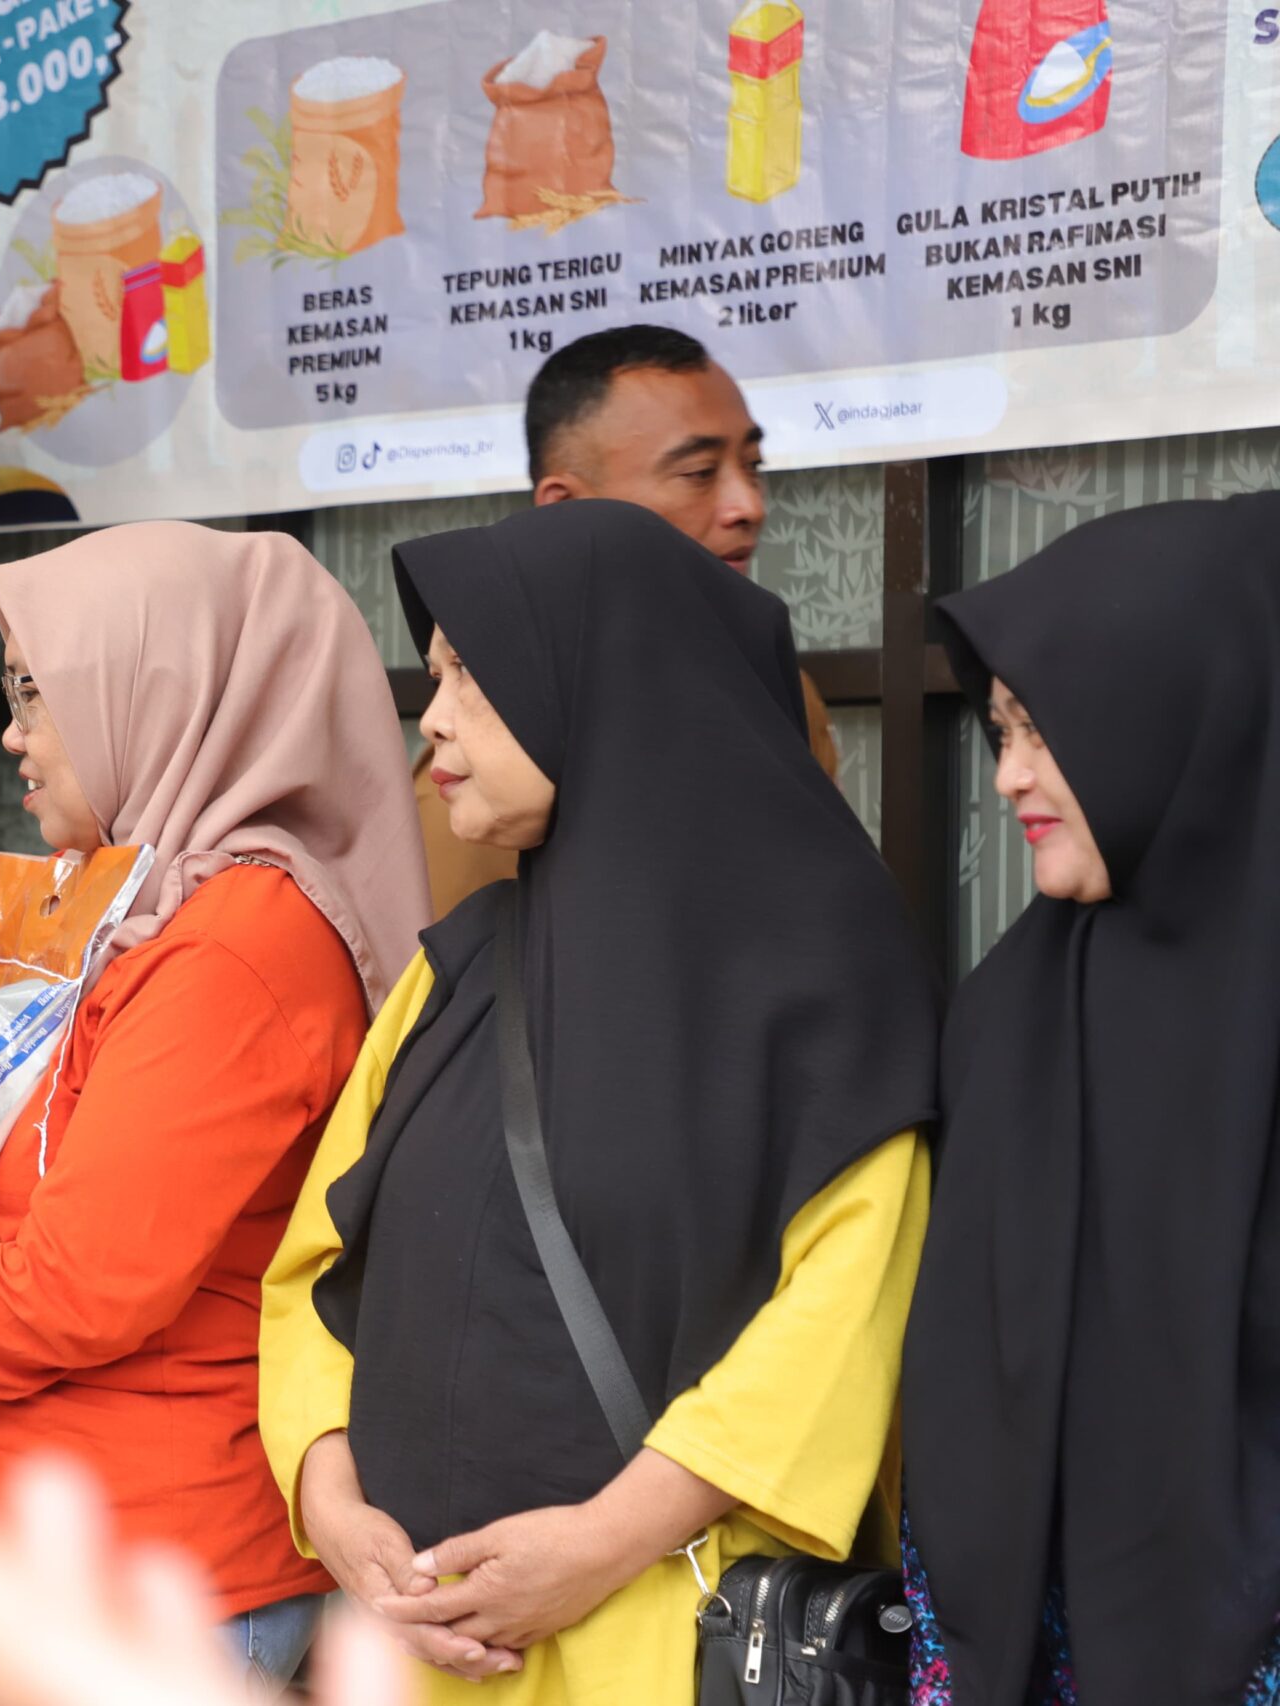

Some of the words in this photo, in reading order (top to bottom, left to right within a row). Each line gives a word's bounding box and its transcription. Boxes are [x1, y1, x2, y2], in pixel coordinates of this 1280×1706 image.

[896, 205, 969, 236] GULA
[980, 186, 1105, 224] KRISTAL
[1111, 171, 1202, 206] PUTIH
[659, 235, 755, 268] MINYAK
[760, 221, 865, 254] GORENG
[925, 234, 1021, 267] BUKAN
[1027, 213, 1167, 254] RAFINASI
[443, 266, 532, 294] TEPUNG
[537, 252, 621, 282] TERIGU
[640, 269, 760, 303] KEMASAN
[765, 253, 887, 288] PREMIUM
[946, 260, 1087, 301] KEMASAN
[1093, 254, 1142, 282] SNI
[303, 285, 373, 312] BERAS
[450, 293, 564, 325] KEMASAN
[570, 288, 608, 311] SNI
[1033, 302, 1072, 330] kg
[287, 314, 388, 345] KEMASAN
[288, 346, 382, 376] PREMIUM
